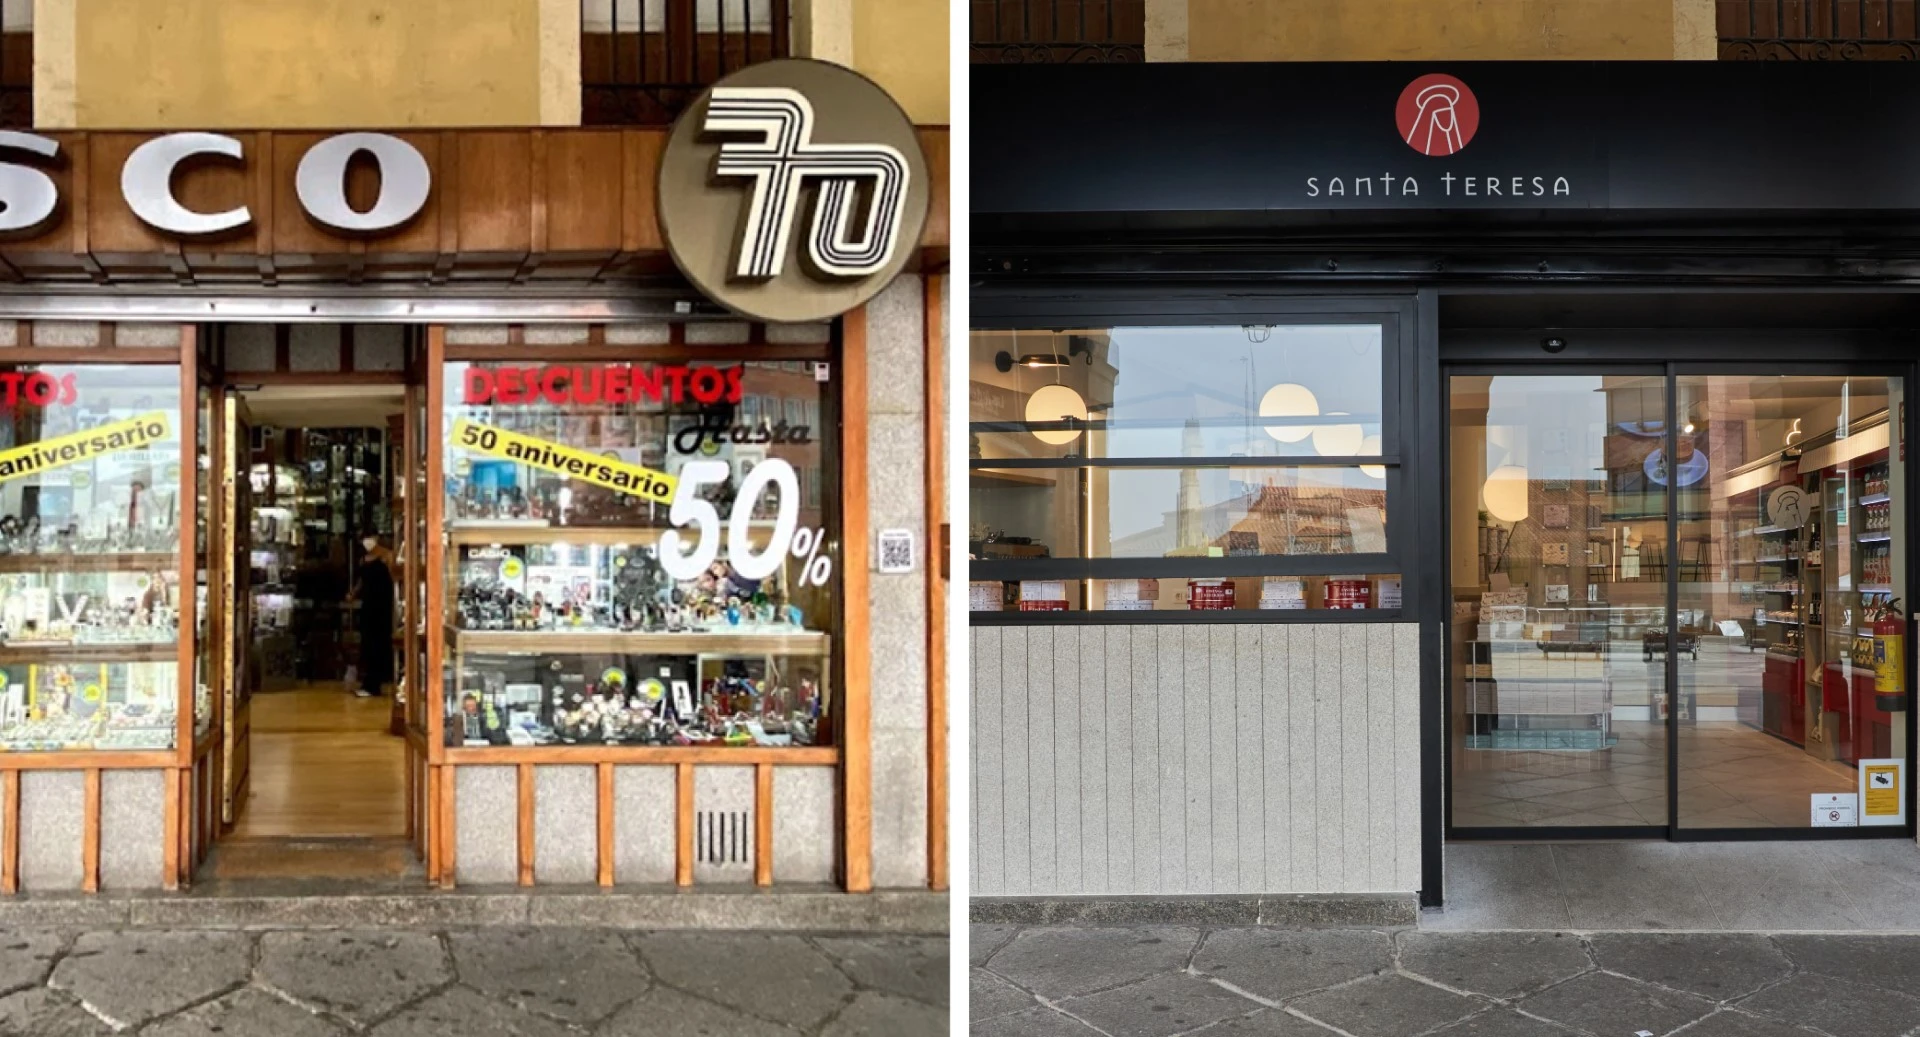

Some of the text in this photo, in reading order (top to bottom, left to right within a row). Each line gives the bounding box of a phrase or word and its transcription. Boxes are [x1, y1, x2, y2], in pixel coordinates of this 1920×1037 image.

[704, 87, 910, 275] 70
[0, 372, 78, 407] TOS
[463, 365, 744, 406] DESCUENTOS
[0, 421, 165, 477] aniversario
[674, 404, 812, 455] Hasta
[462, 424, 669, 497] 50 aniversario
[468, 548, 511, 559] CASIO
